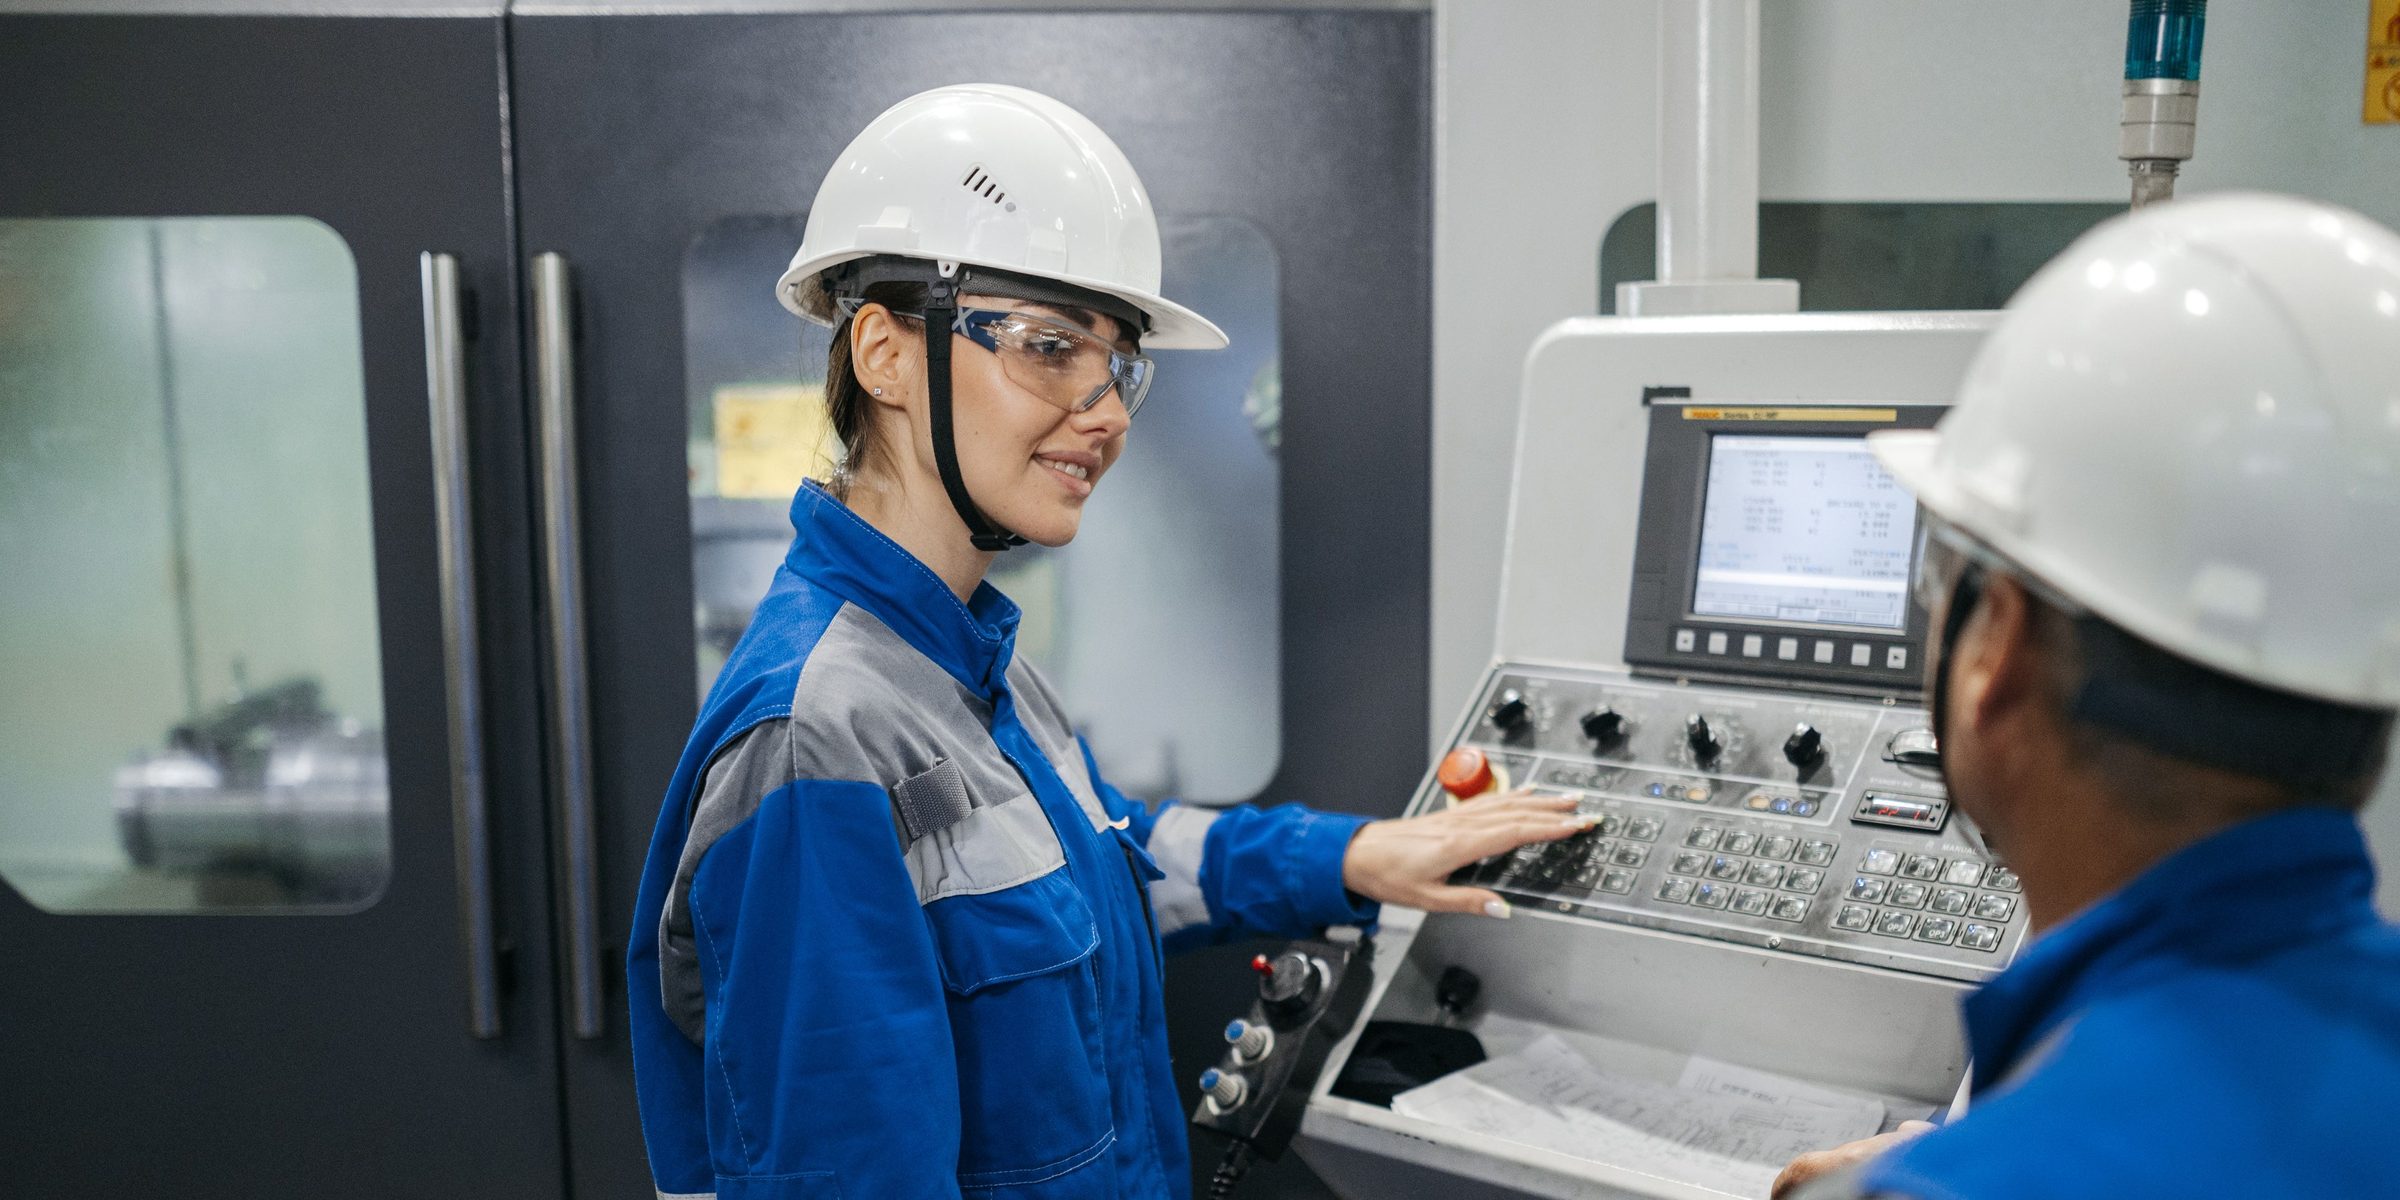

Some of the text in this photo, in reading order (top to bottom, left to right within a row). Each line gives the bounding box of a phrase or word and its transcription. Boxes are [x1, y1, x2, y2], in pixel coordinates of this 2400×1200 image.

[1942, 844, 1978, 856] MANUAL
[1846, 918, 1863, 926] OP1
[1887, 923, 1904, 932] OP2
[1928, 929, 1946, 938] OP3
